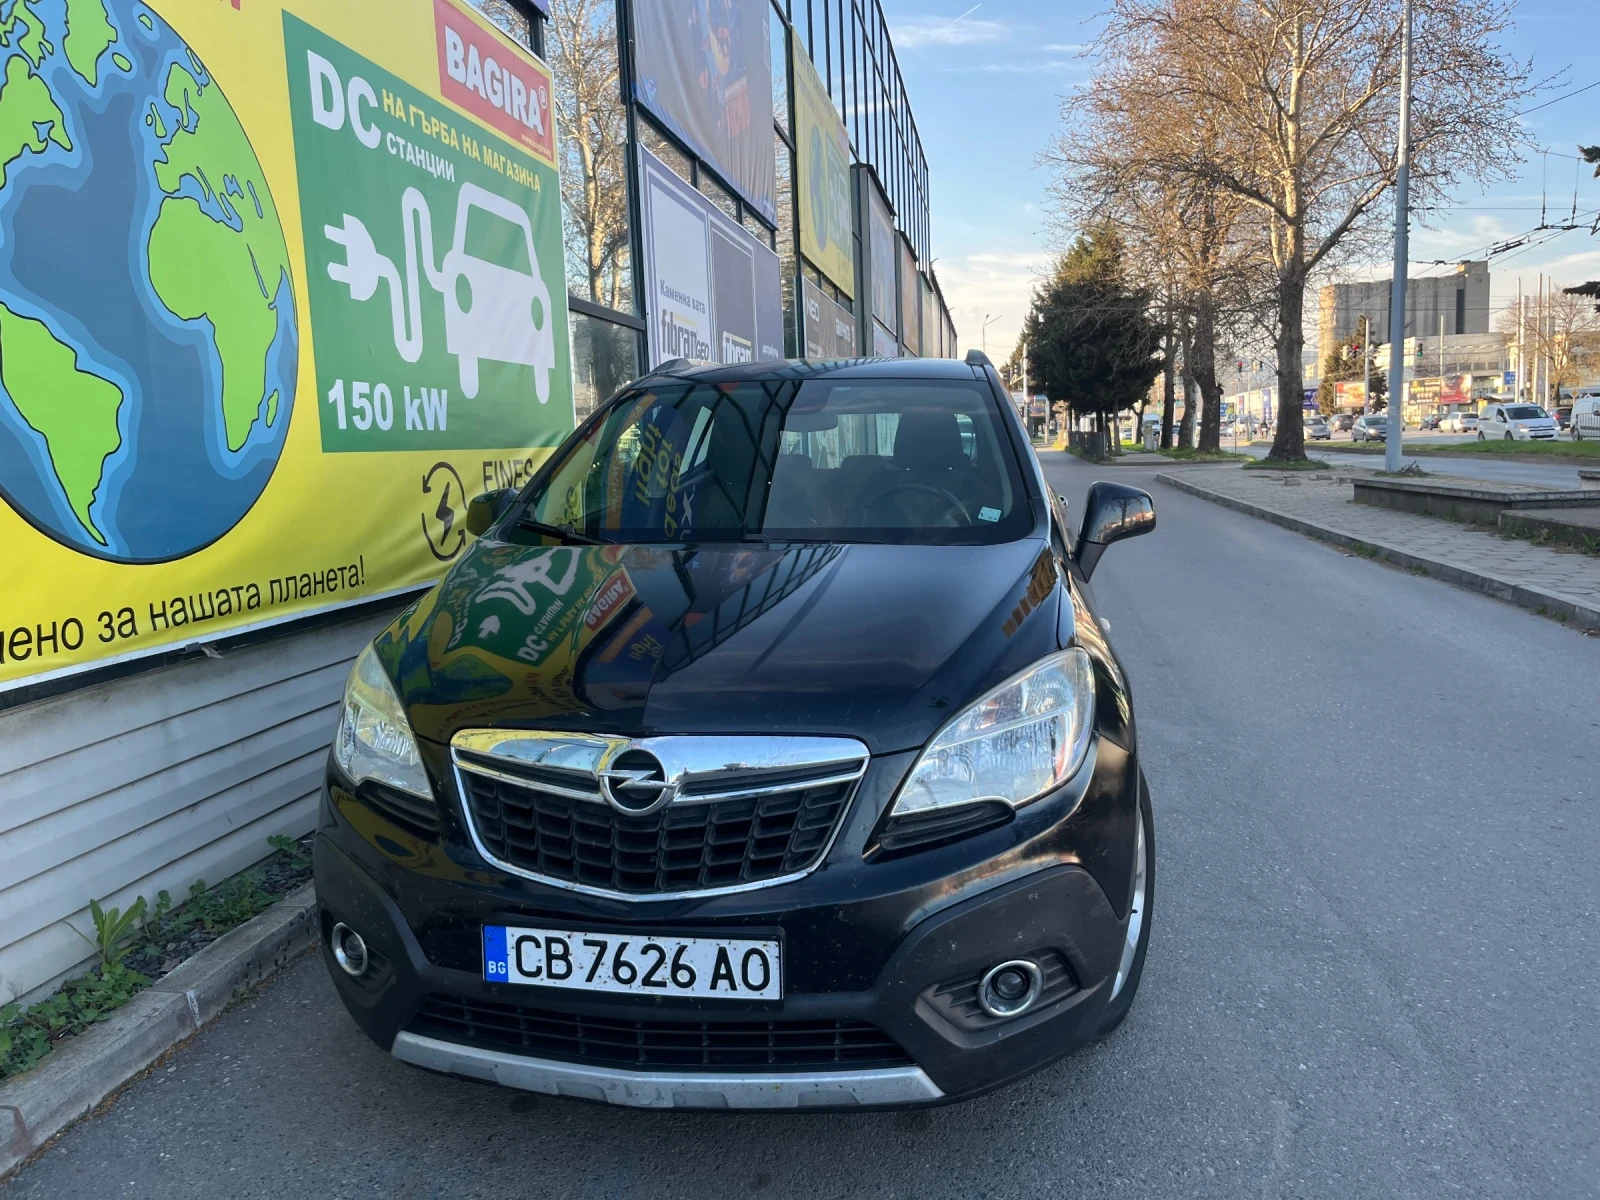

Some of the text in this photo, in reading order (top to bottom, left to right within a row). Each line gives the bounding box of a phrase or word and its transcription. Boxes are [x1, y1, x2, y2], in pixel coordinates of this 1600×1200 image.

[307, 49, 382, 149] DC
[382, 88, 541, 193] НА ГЪРБА НА МАГАЗИНА
[386, 132, 456, 183] СТАНЦИИ
[660, 278, 706, 314] Каменна вата
[328, 378, 448, 431] 150 kW
[483, 457, 534, 493] FINES
[97, 605, 139, 643] за
[149, 581, 262, 633] нашата
[269, 554, 366, 606] планета!
[487, 960, 506, 975] BG
[515, 934, 771, 992] CB 7626 AO
